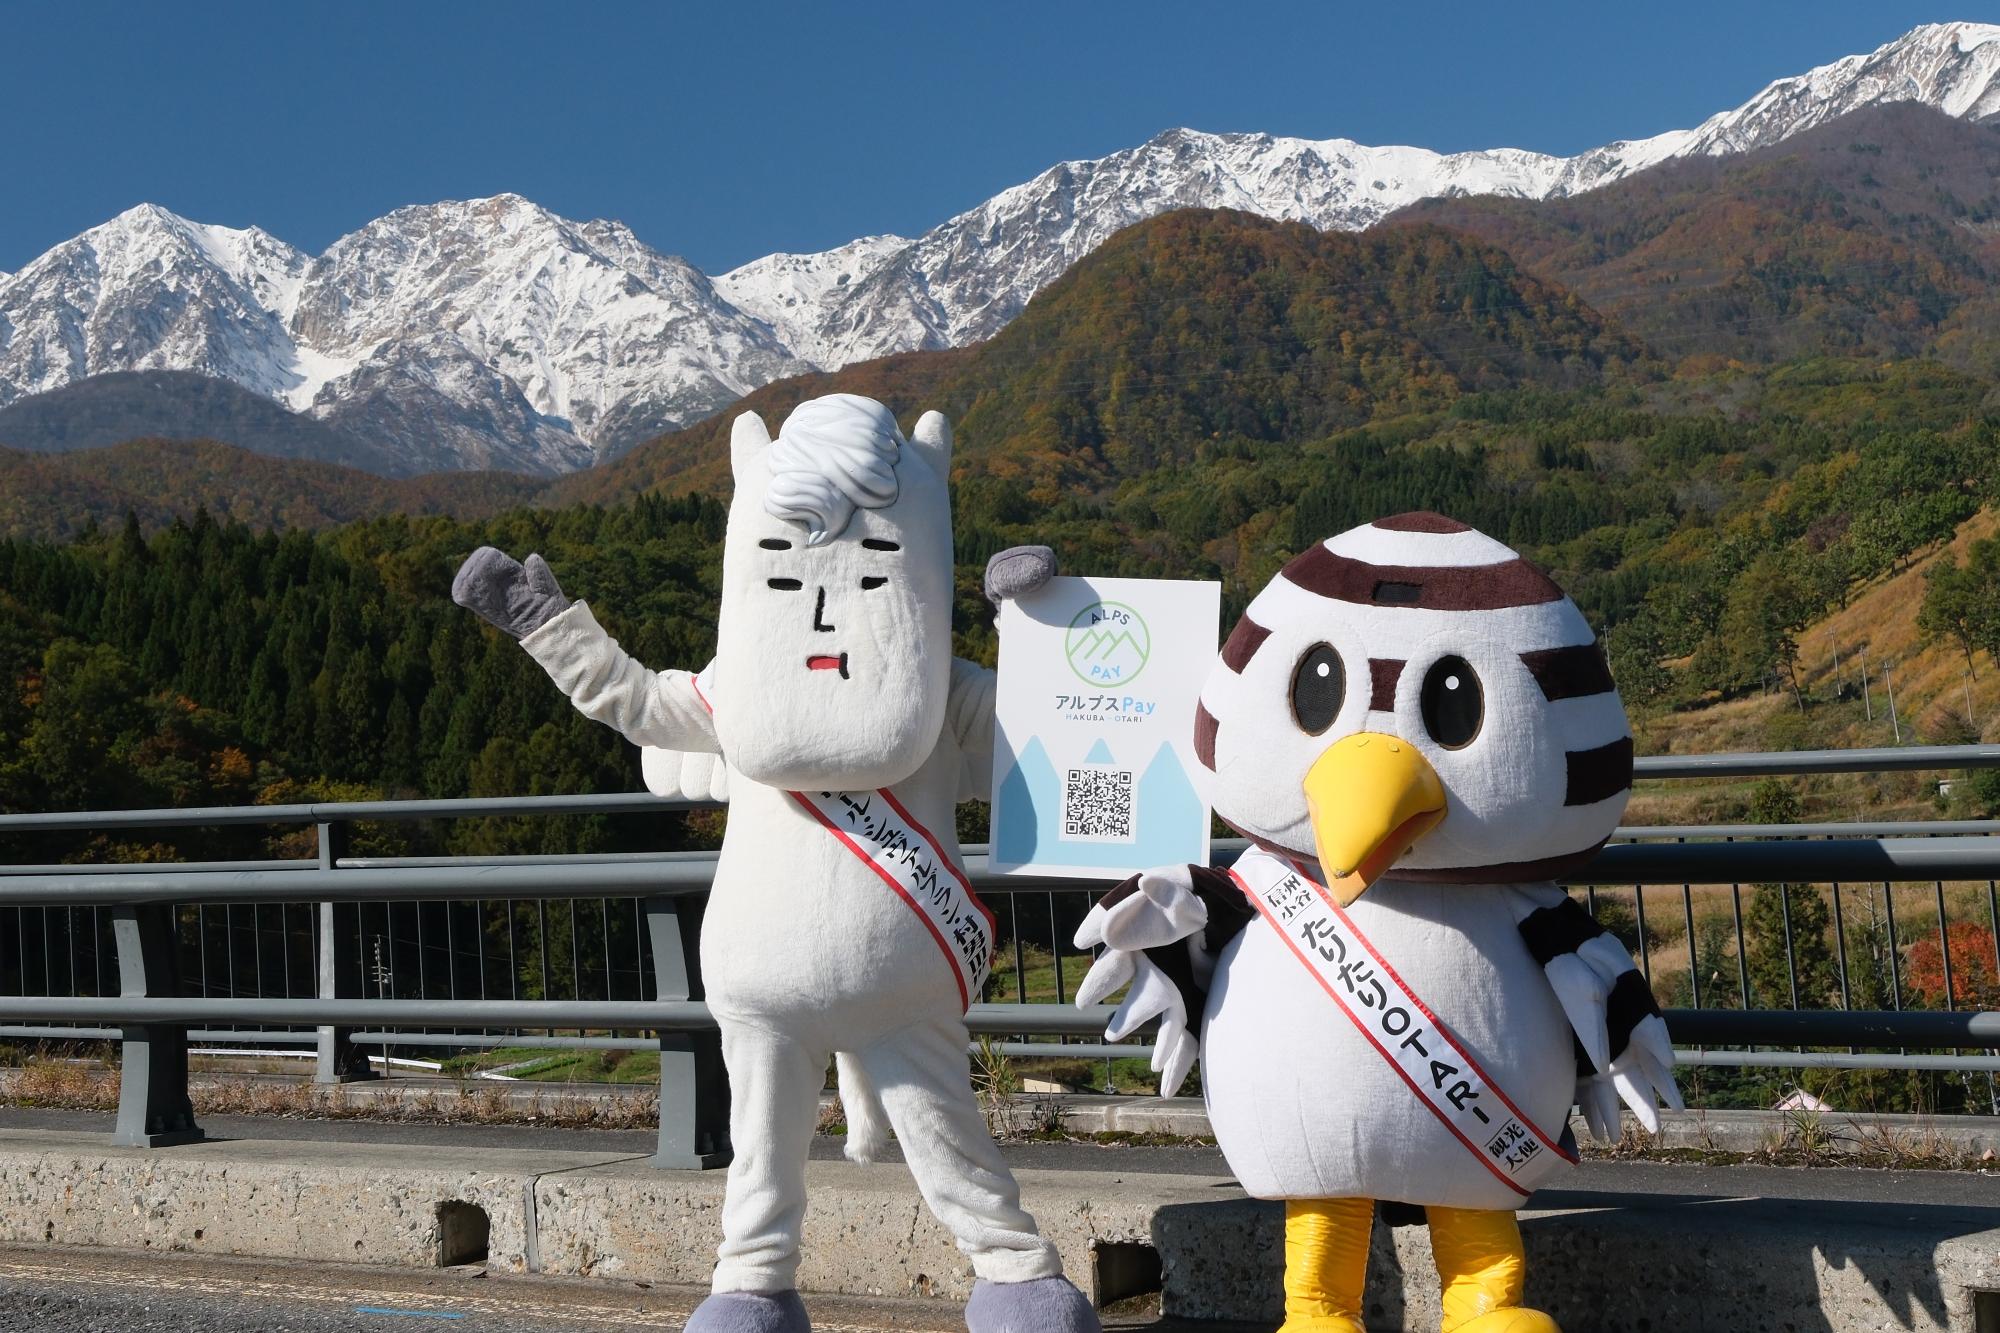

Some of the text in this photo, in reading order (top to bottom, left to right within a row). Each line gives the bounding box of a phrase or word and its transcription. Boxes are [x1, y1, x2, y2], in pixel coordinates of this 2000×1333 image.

[1091, 608, 1131, 625] ALPS
[1090, 665, 1121, 680] PAY
[1065, 713, 1143, 723] HAKUBA OTARI
[1281, 889, 1312, 920] 小谷
[1488, 1123, 1525, 1159] 観光
[1504, 1138, 1540, 1171] 大使
